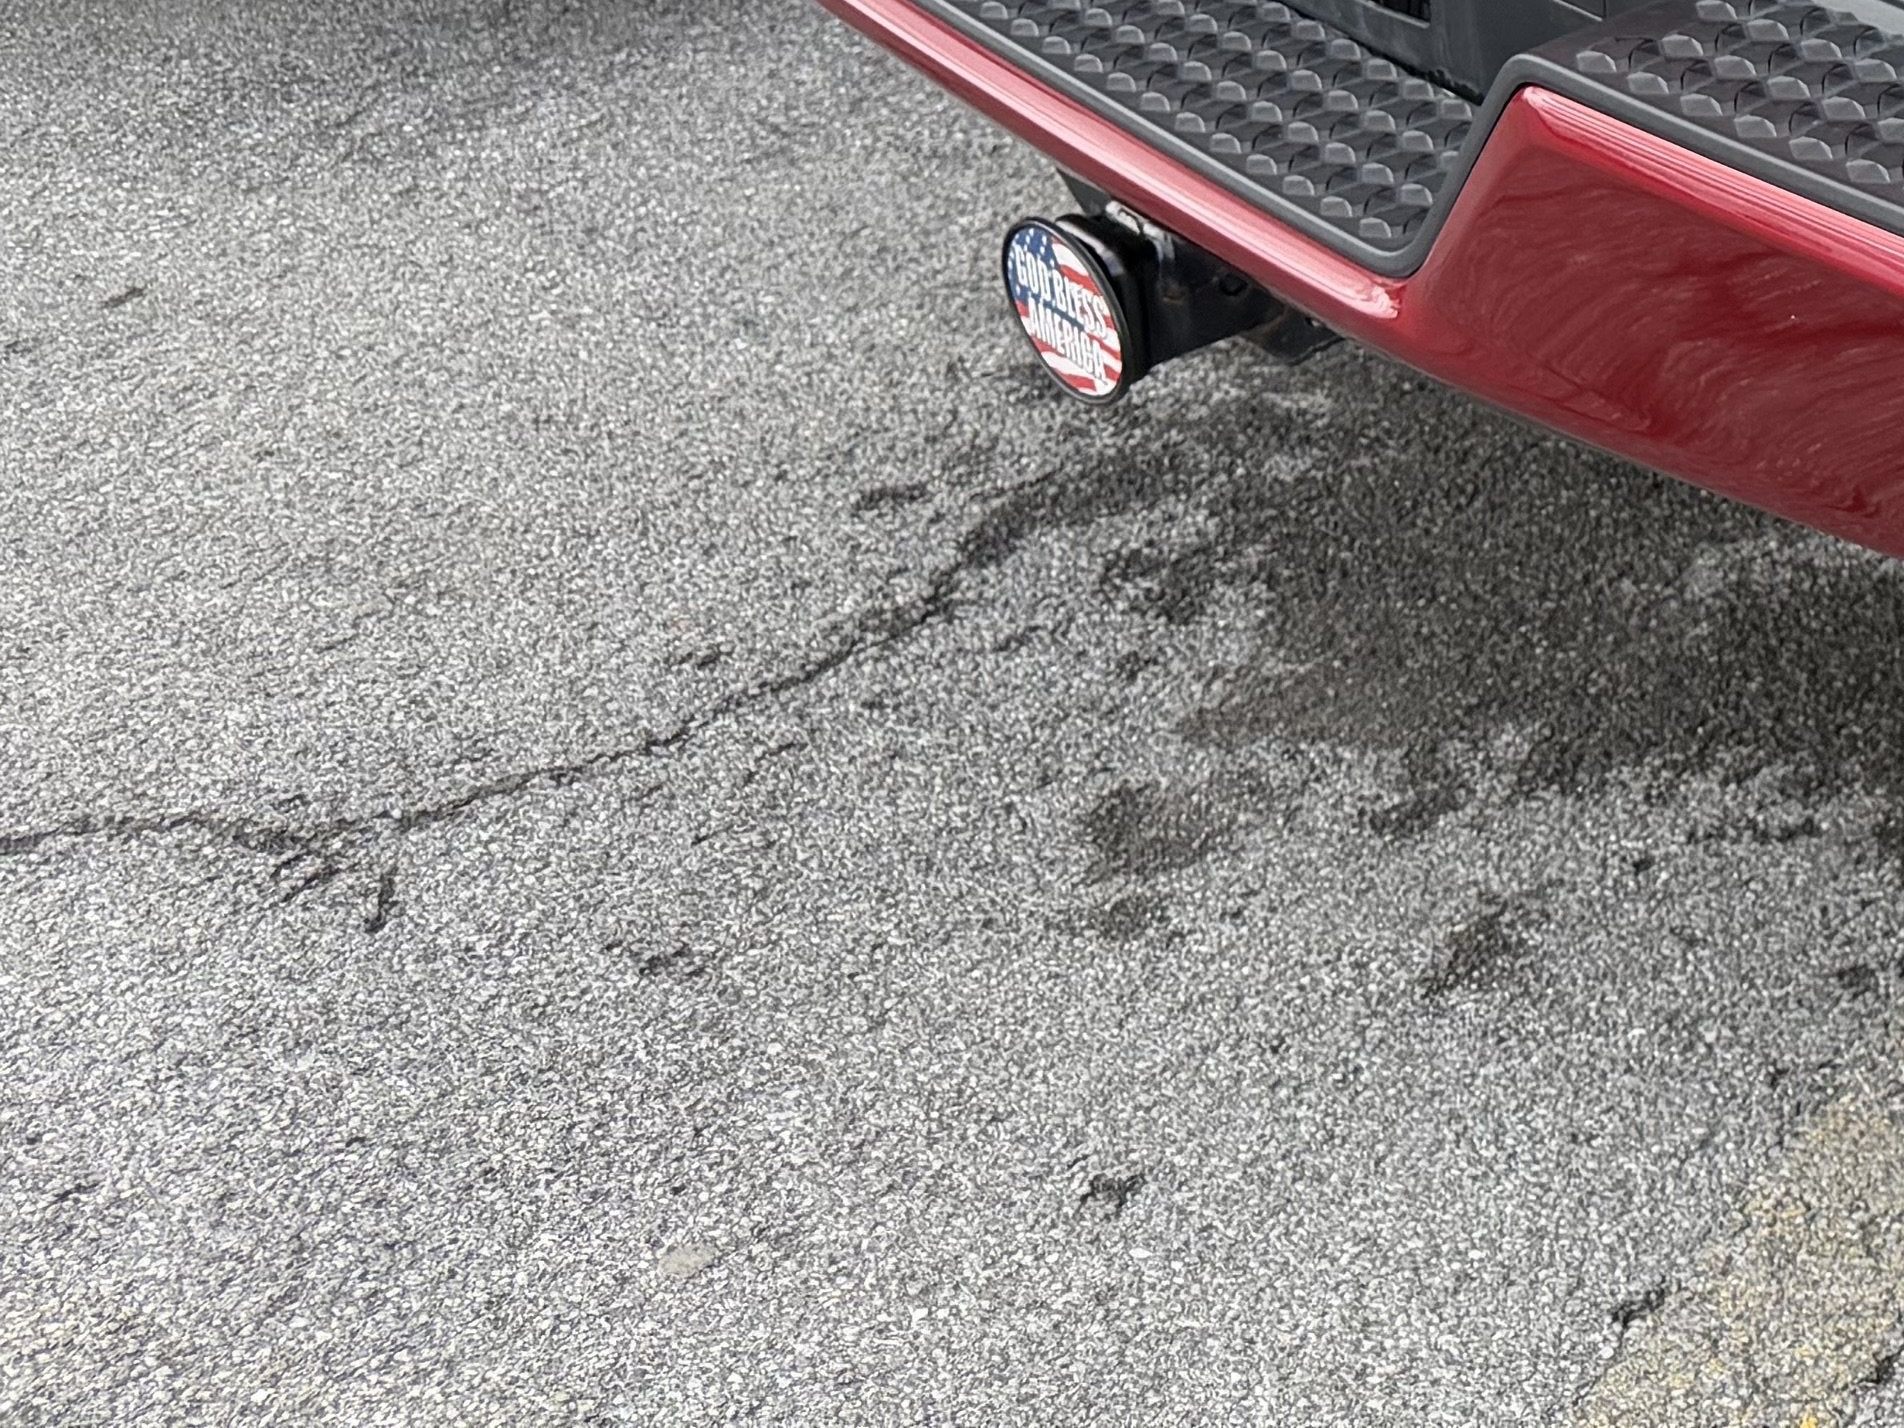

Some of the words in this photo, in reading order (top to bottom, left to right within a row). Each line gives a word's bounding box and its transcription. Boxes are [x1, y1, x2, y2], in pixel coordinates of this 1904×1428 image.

[1015, 248, 1054, 303] GOD
[1053, 268, 1108, 339] BLESS
[1027, 298, 1107, 381] AMERICA
